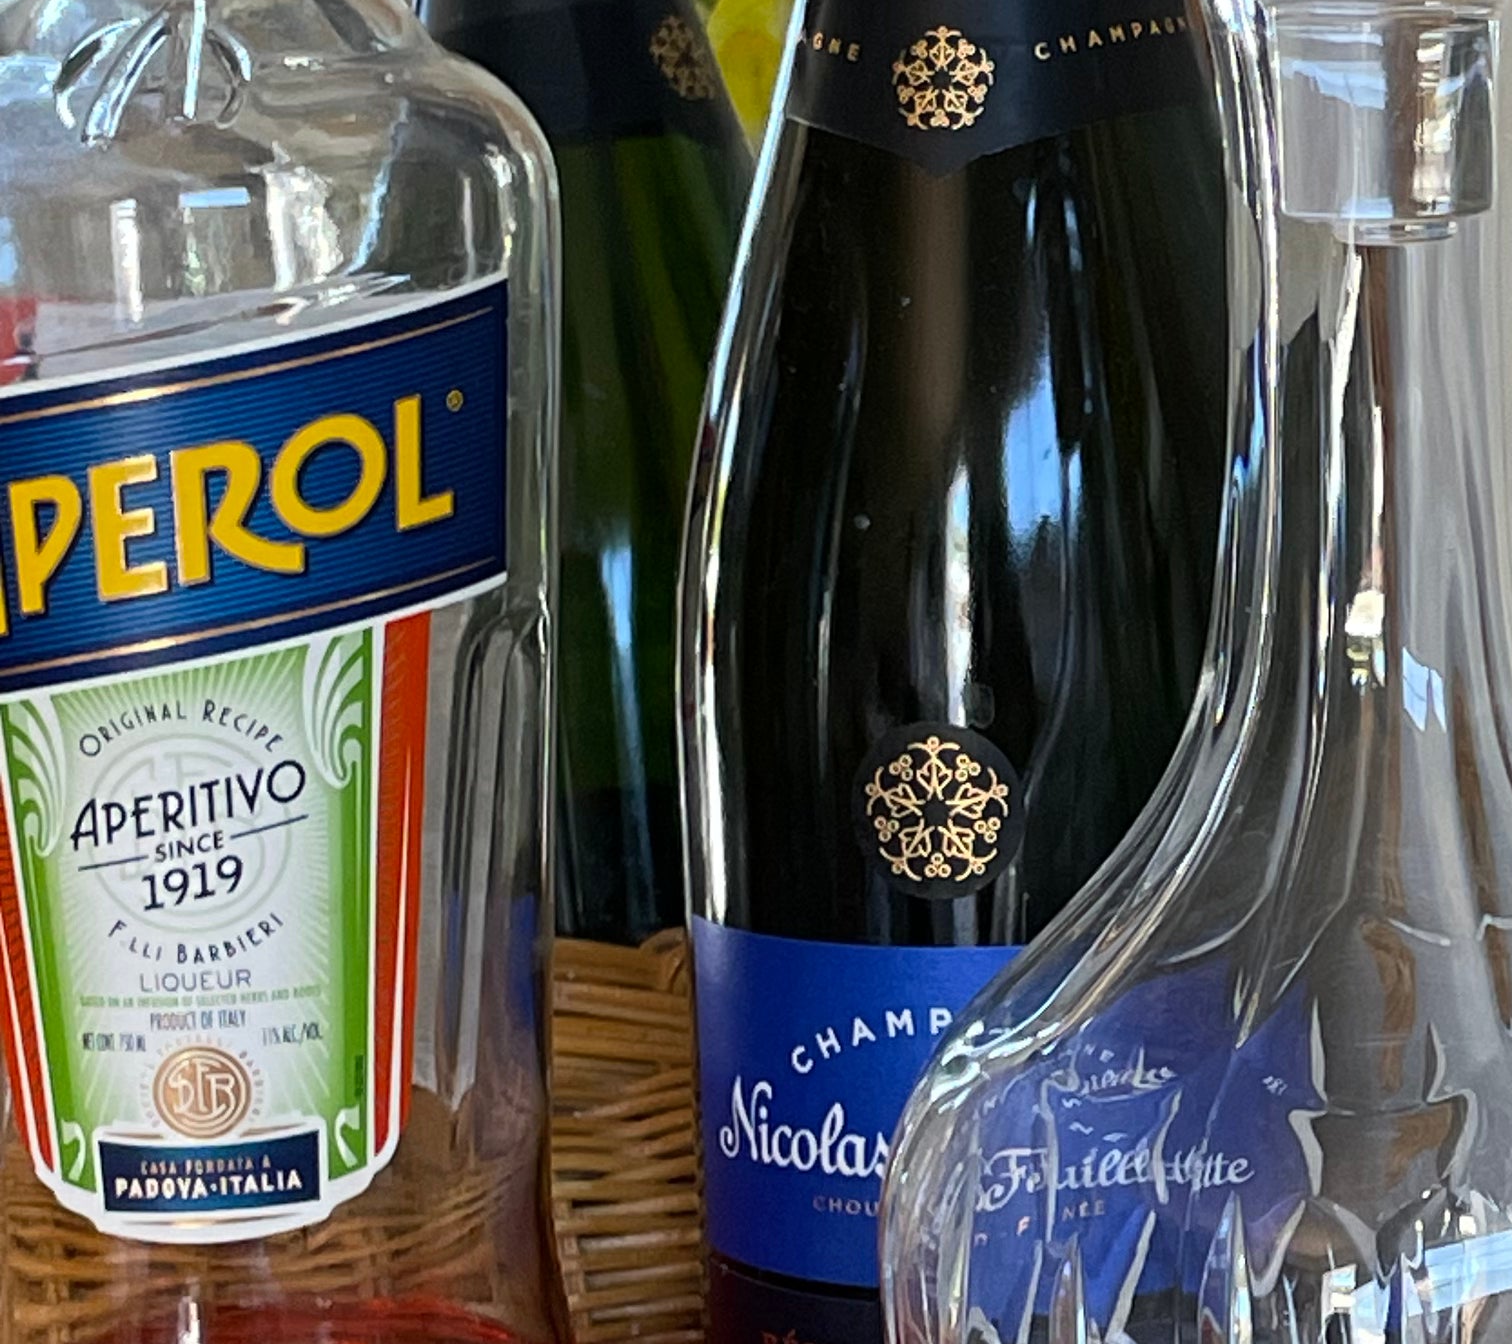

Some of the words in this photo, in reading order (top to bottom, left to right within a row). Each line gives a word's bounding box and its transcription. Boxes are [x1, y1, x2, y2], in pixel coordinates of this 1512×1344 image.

[0, 394, 455, 637] PEROL
[79, 699, 188, 757] ORIGINAL
[203, 698, 284, 753] RECIPE
[70, 759, 306, 851] APERITIVO
[154, 830, 225, 863] SINCE
[142, 854, 244, 912] 1919
[176, 912, 284, 965] BARBIERI
[139, 968, 252, 993] LIQUEUR
[719, 1074, 889, 1180] Nicolas
